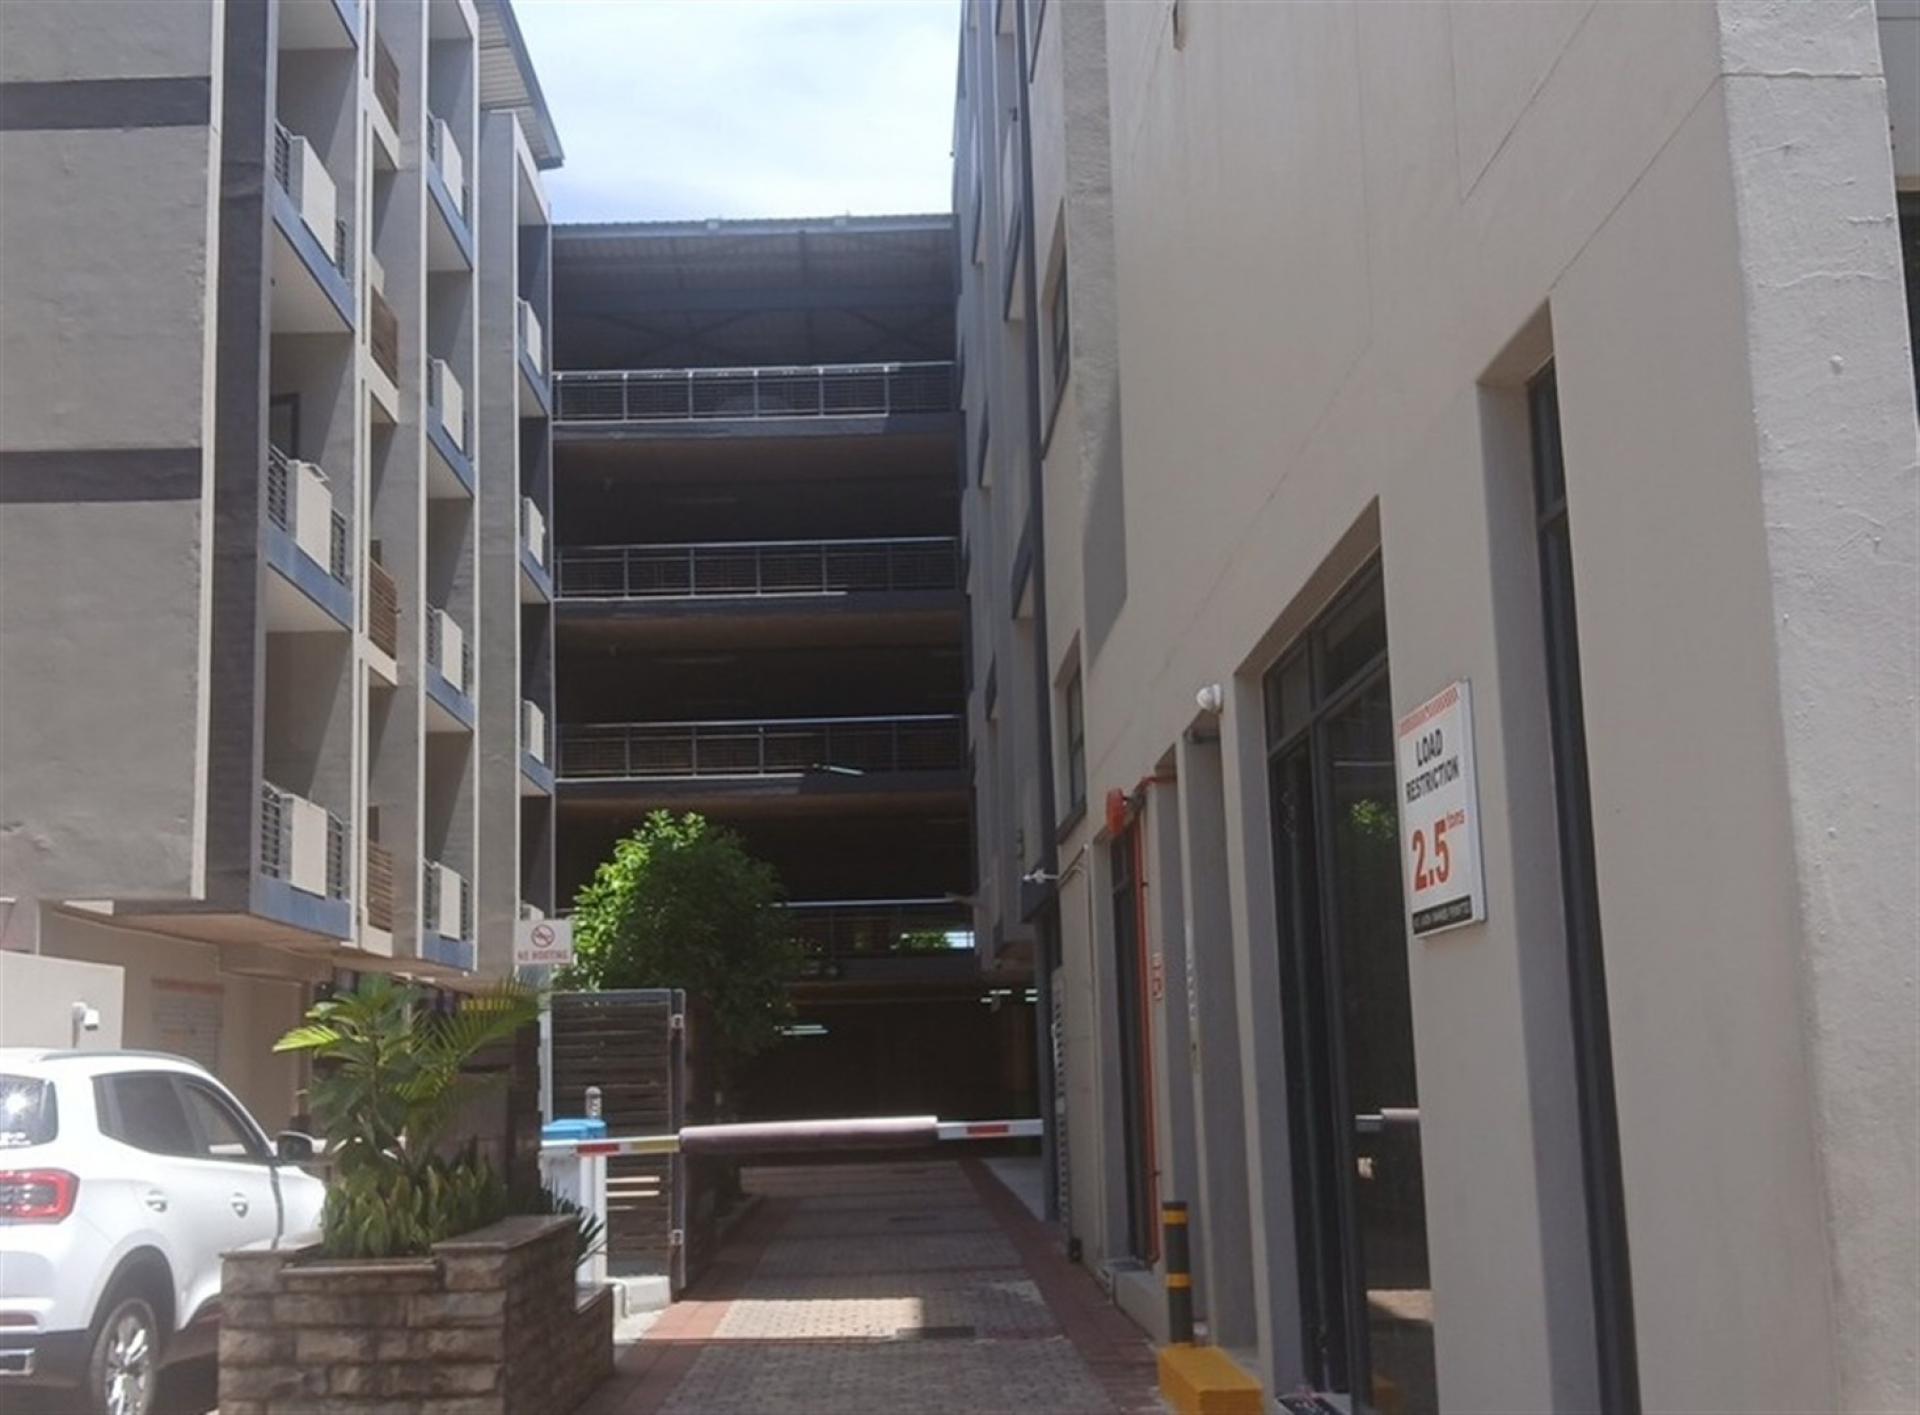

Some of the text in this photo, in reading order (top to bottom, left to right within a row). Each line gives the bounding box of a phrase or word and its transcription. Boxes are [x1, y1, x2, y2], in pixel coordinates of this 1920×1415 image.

[1416, 728, 1443, 767] LOAD
[1405, 755, 1459, 803] RESTRICTION
[1412, 818, 1449, 891] 2.5
